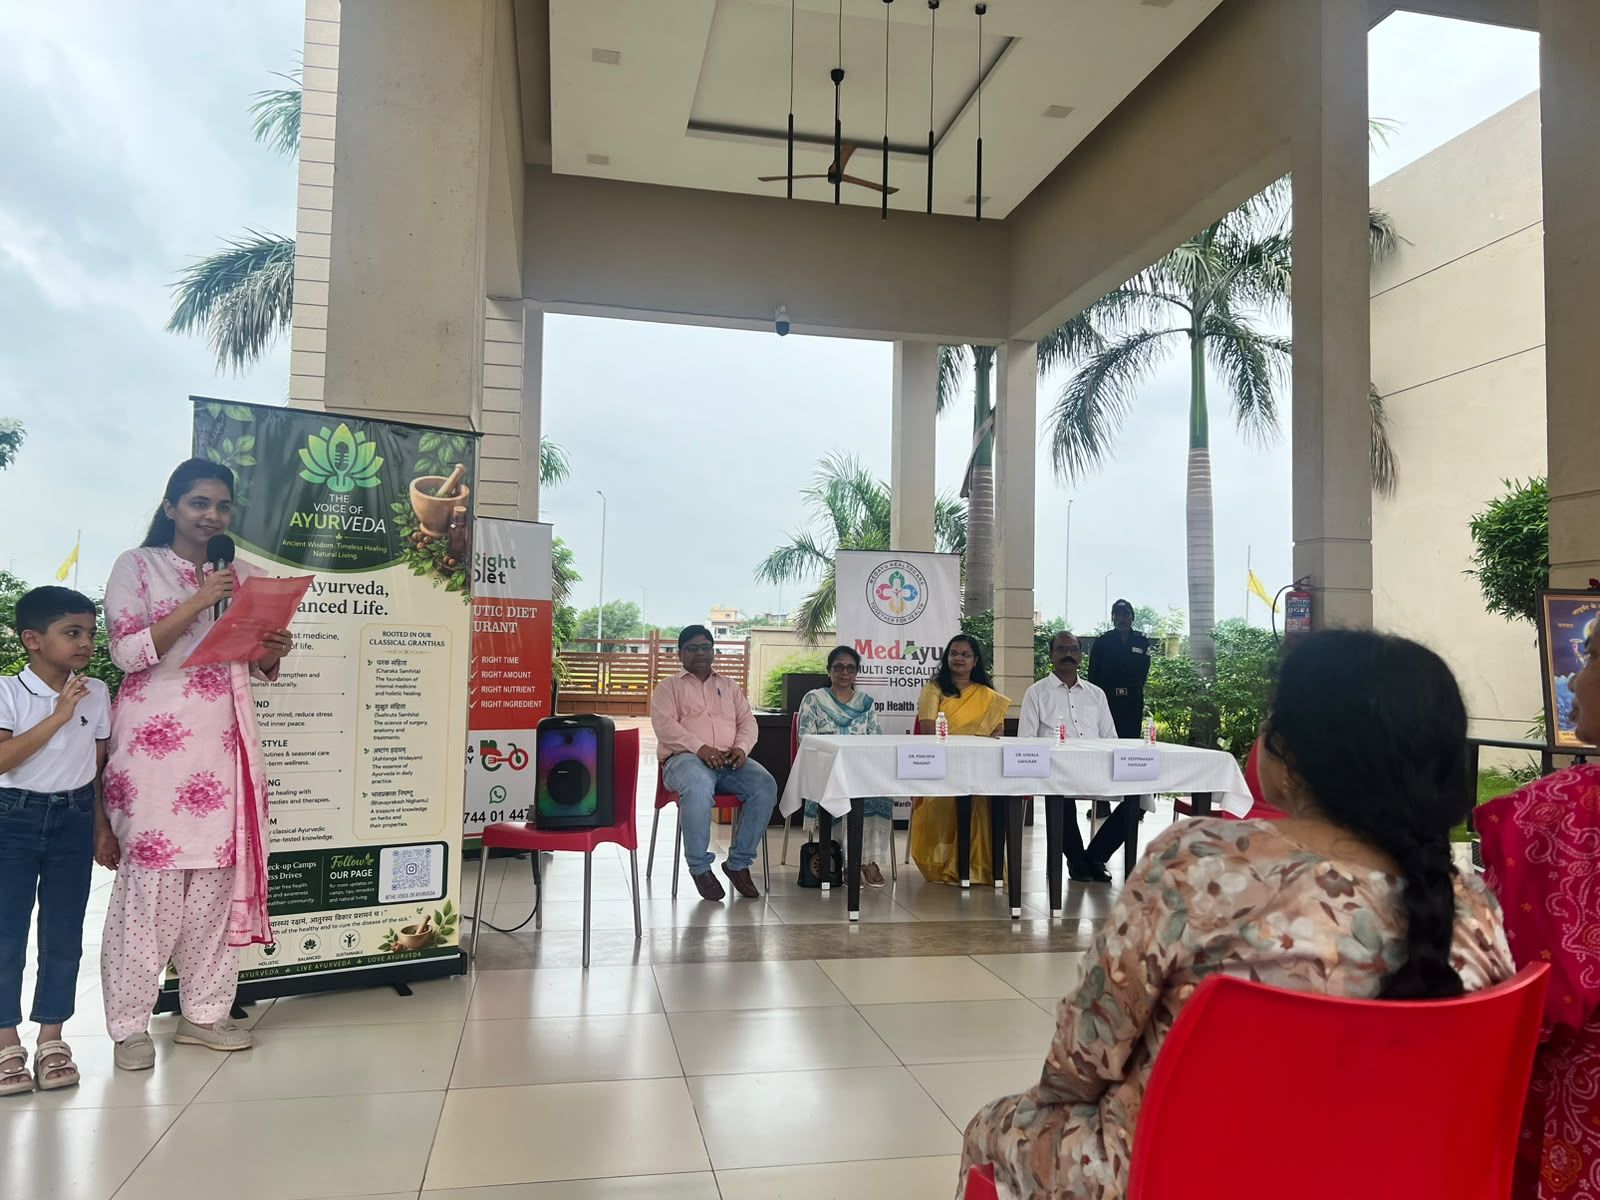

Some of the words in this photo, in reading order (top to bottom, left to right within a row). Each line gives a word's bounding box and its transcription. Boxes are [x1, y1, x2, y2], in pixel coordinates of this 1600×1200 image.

[329, 494, 350, 503] THE
[314, 502, 346, 513] VOICE
[349, 505, 363, 514] OF
[290, 512, 386, 534] AYURVEDA
[337, 542, 363, 551] Timeless
[364, 545, 388, 554] Healing
[338, 552, 358, 560] Living
[308, 579, 390, 598] Ayurveda,
[297, 599, 348, 614] anced
[352, 600, 388, 616] Life.
[474, 604, 503, 618] UTIC
[507, 606, 538, 619] DIET
[474, 620, 518, 634] URANT
[302, 632, 340, 640] medicine,
[300, 642, 314, 650] life.
[854, 638, 944, 665] MedAyu
[859, 665, 884, 674] ULTI
[256, 700, 270, 708] ND
[480, 700, 502, 708] RIGHT
[502, 700, 542, 708] INGREDIENT
[874, 702, 884, 712] op
[886, 700, 915, 712] Health
[262, 739, 288, 748] STYLE
[468, 745, 474, 754] &
[268, 779, 280, 787] NG
[490, 810, 504, 822] 01
[268, 862, 292, 871] eck-up
[292, 862, 317, 870] Camps
[330, 854, 366, 869] Follow
[280, 872, 302, 880] Drives
[330, 870, 349, 880] OUR
[350, 869, 373, 878] PAGE
[240, 968, 280, 979] AYURVEDA
[296, 964, 314, 972] LIVE
[314, 960, 352, 970] AYURVEDA
[368, 956, 386, 964] LOVE
[387, 952, 422, 962] AYURVEDA
